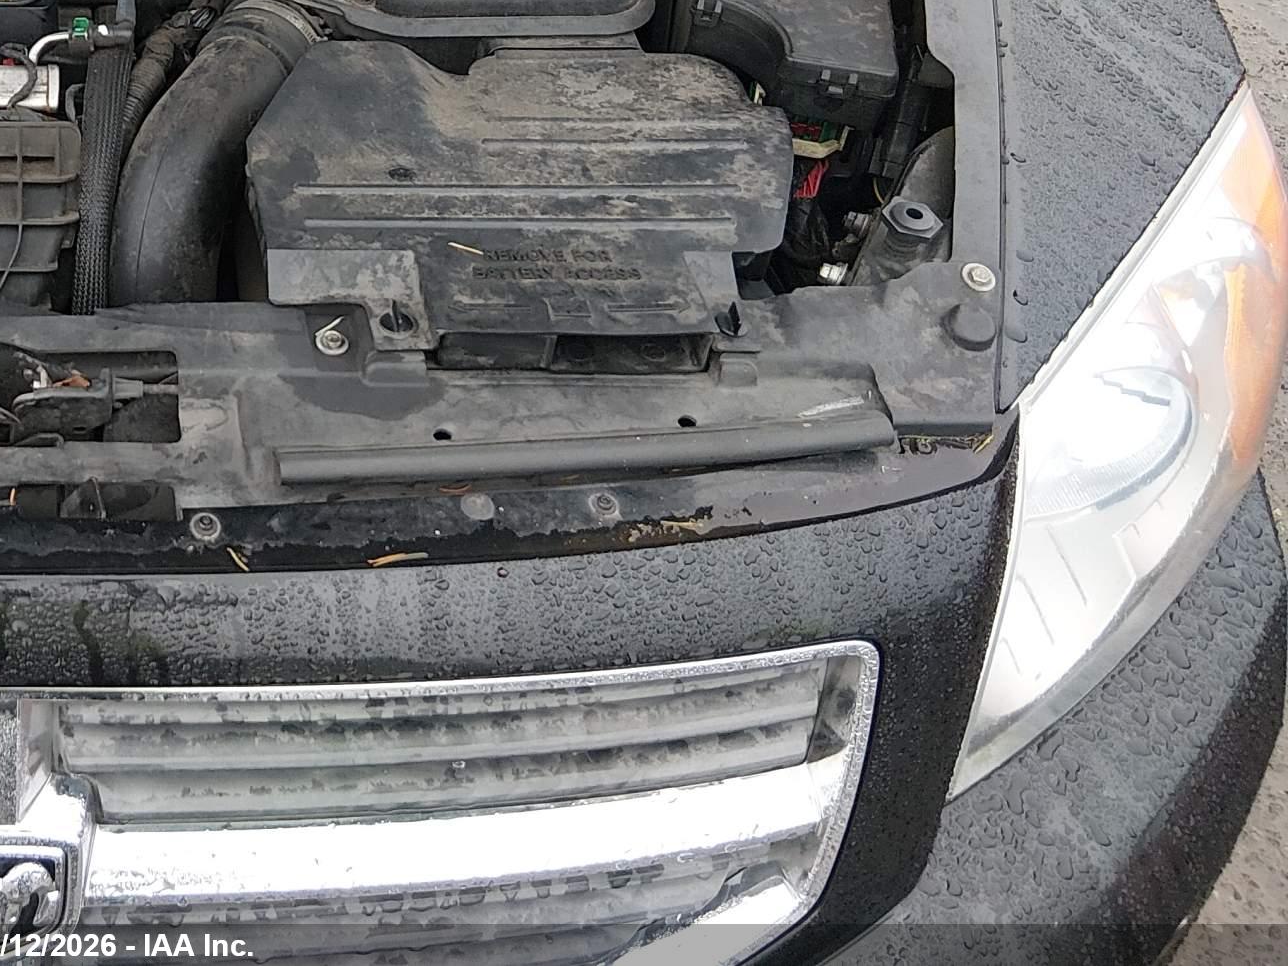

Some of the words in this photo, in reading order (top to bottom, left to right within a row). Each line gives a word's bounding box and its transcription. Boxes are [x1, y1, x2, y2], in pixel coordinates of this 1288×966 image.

[483, 248, 567, 263] REMOVE
[570, 248, 614, 263] FOR
[471, 266, 554, 280] BATTERY
[563, 266, 643, 281] ACCESS
